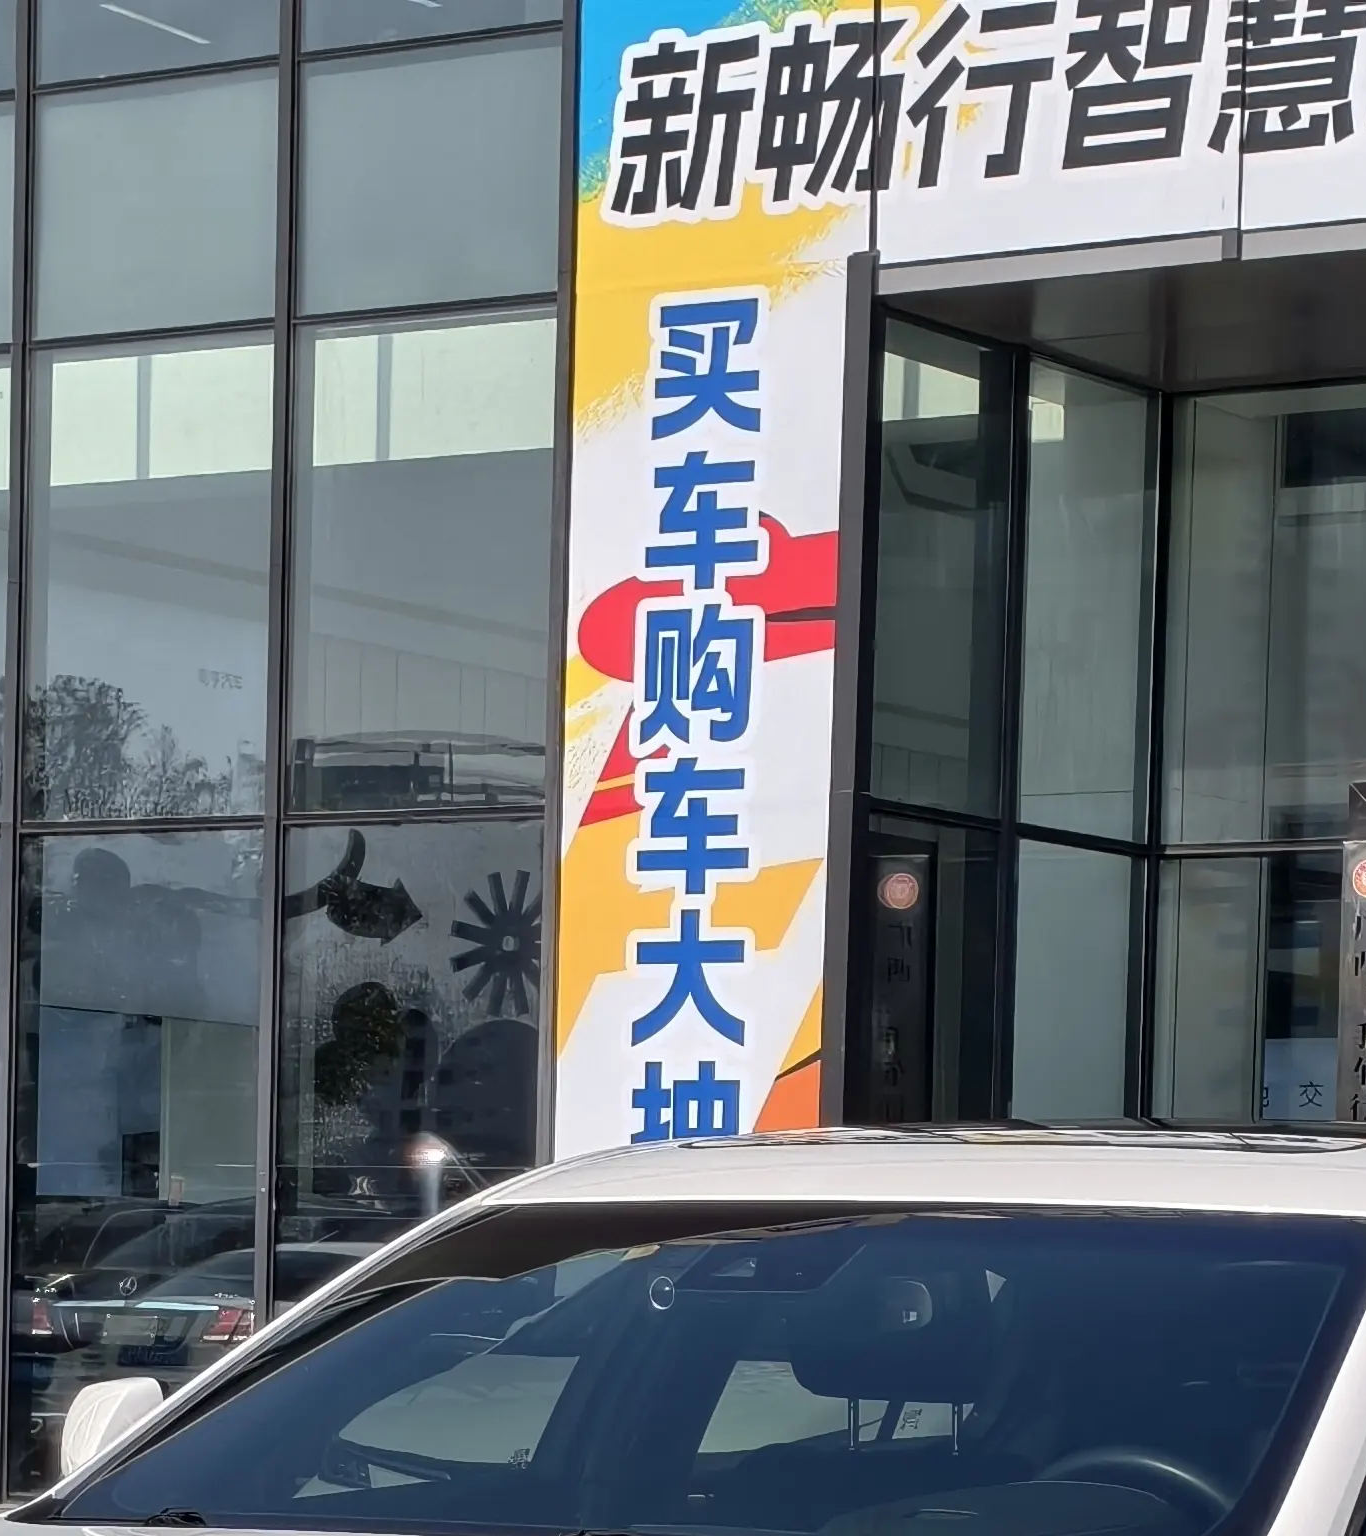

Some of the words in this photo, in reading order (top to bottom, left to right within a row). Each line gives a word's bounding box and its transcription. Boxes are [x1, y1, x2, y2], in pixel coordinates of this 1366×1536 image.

[630, 297, 762, 1144] 买车购车大抽
